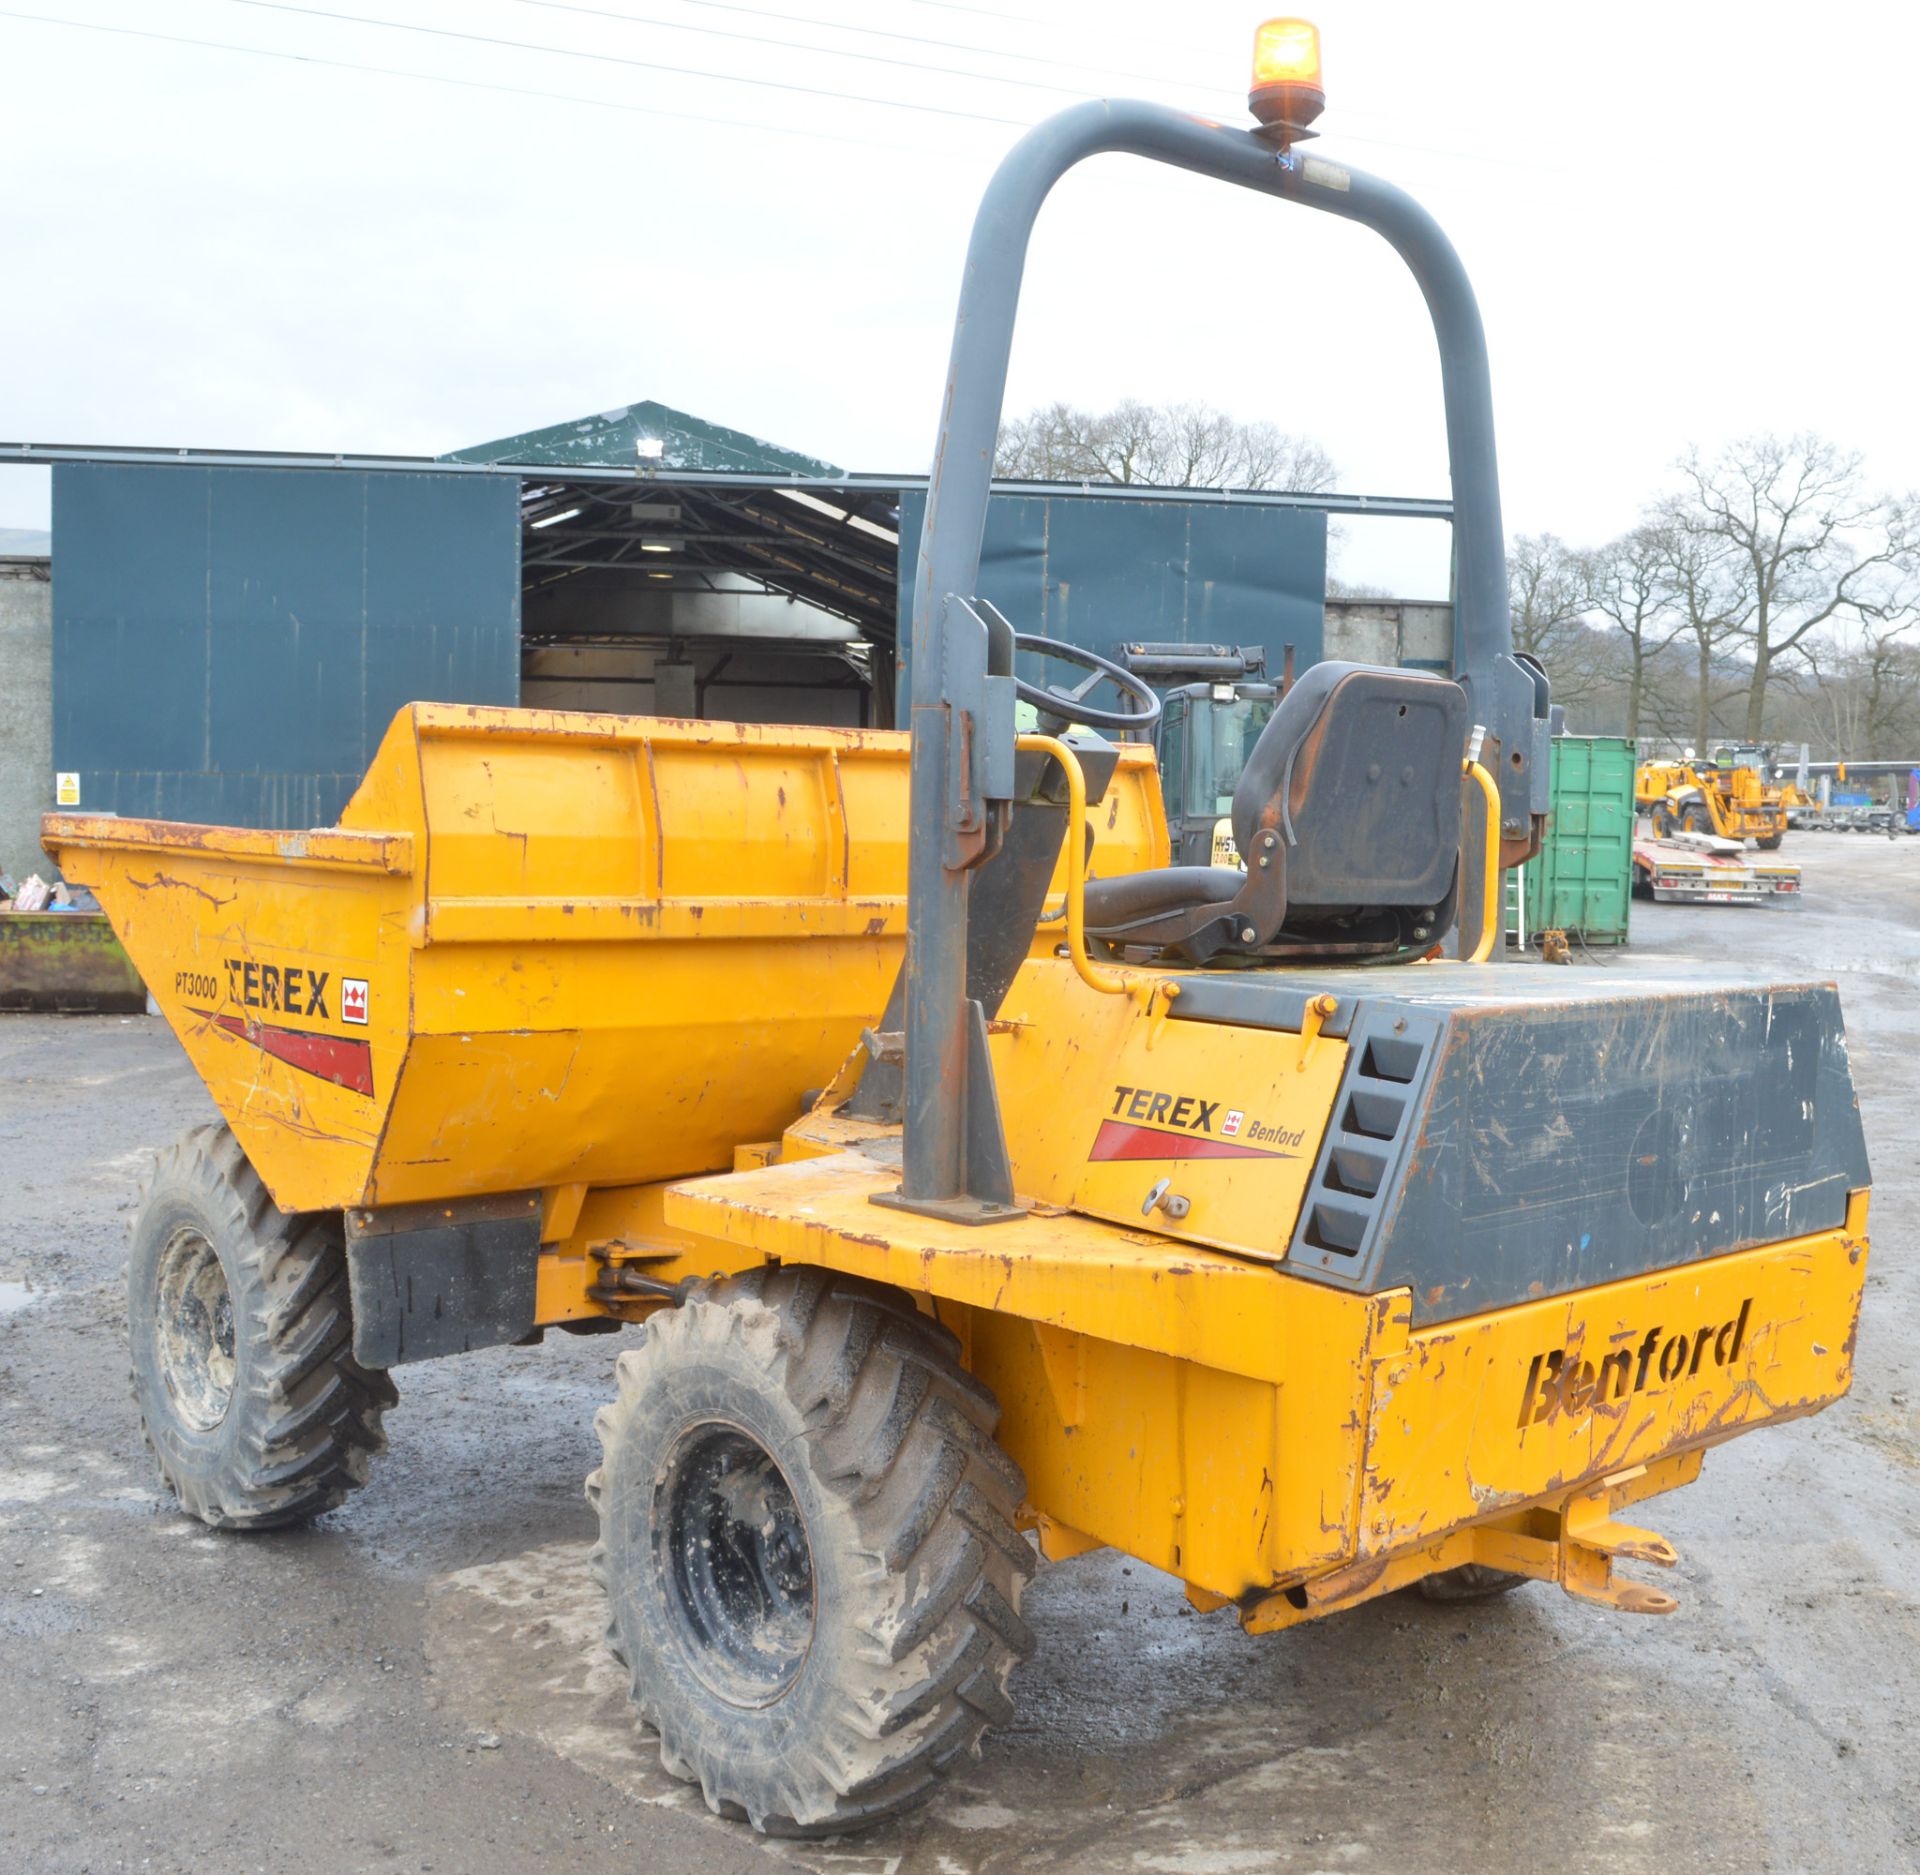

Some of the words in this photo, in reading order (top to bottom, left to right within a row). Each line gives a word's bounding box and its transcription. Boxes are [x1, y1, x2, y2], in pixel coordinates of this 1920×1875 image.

[176, 972, 217, 1000] PT3000
[224, 959, 329, 1019] TEREX
[1112, 1086, 1220, 1132] TEREX
[1247, 1120, 1305, 1147] Benford
[1517, 1298, 1753, 1429] Benford
